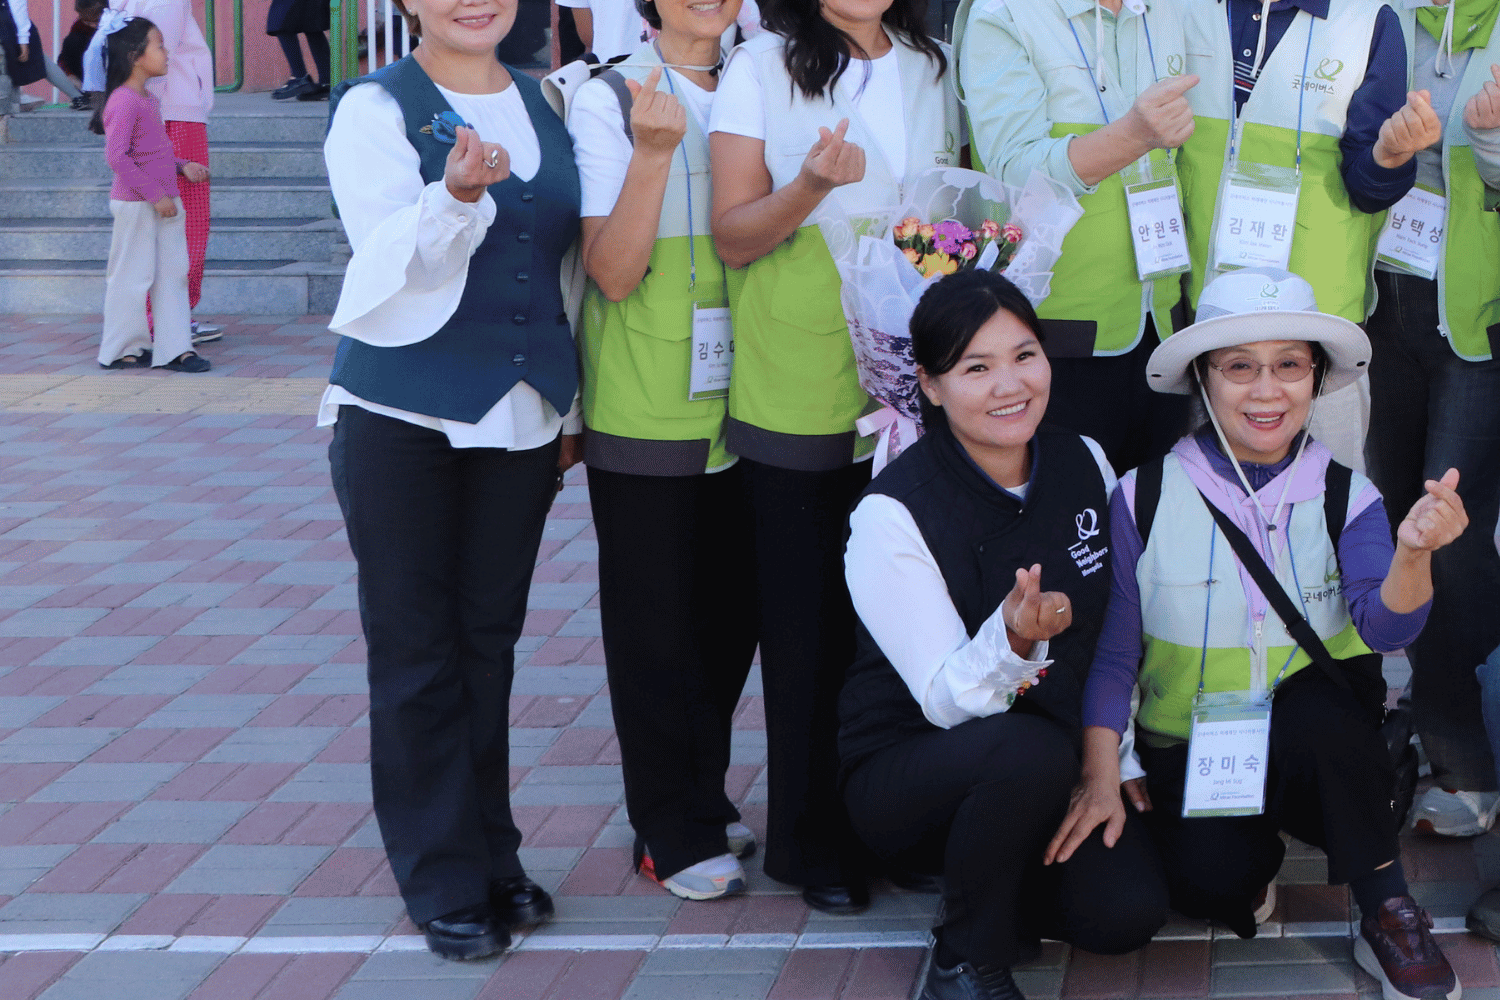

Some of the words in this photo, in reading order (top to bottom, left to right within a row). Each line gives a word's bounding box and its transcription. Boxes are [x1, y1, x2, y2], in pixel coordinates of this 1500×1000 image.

[1138, 217, 1180, 243] 안원욱
[1229, 216, 1288, 242] 김재환
[1391, 212, 1443, 244] 남택성
[1070, 544, 1091, 559] Good
[1075, 546, 1109, 568] Neighbors
[1197, 754, 1261, 777] 장미숙
